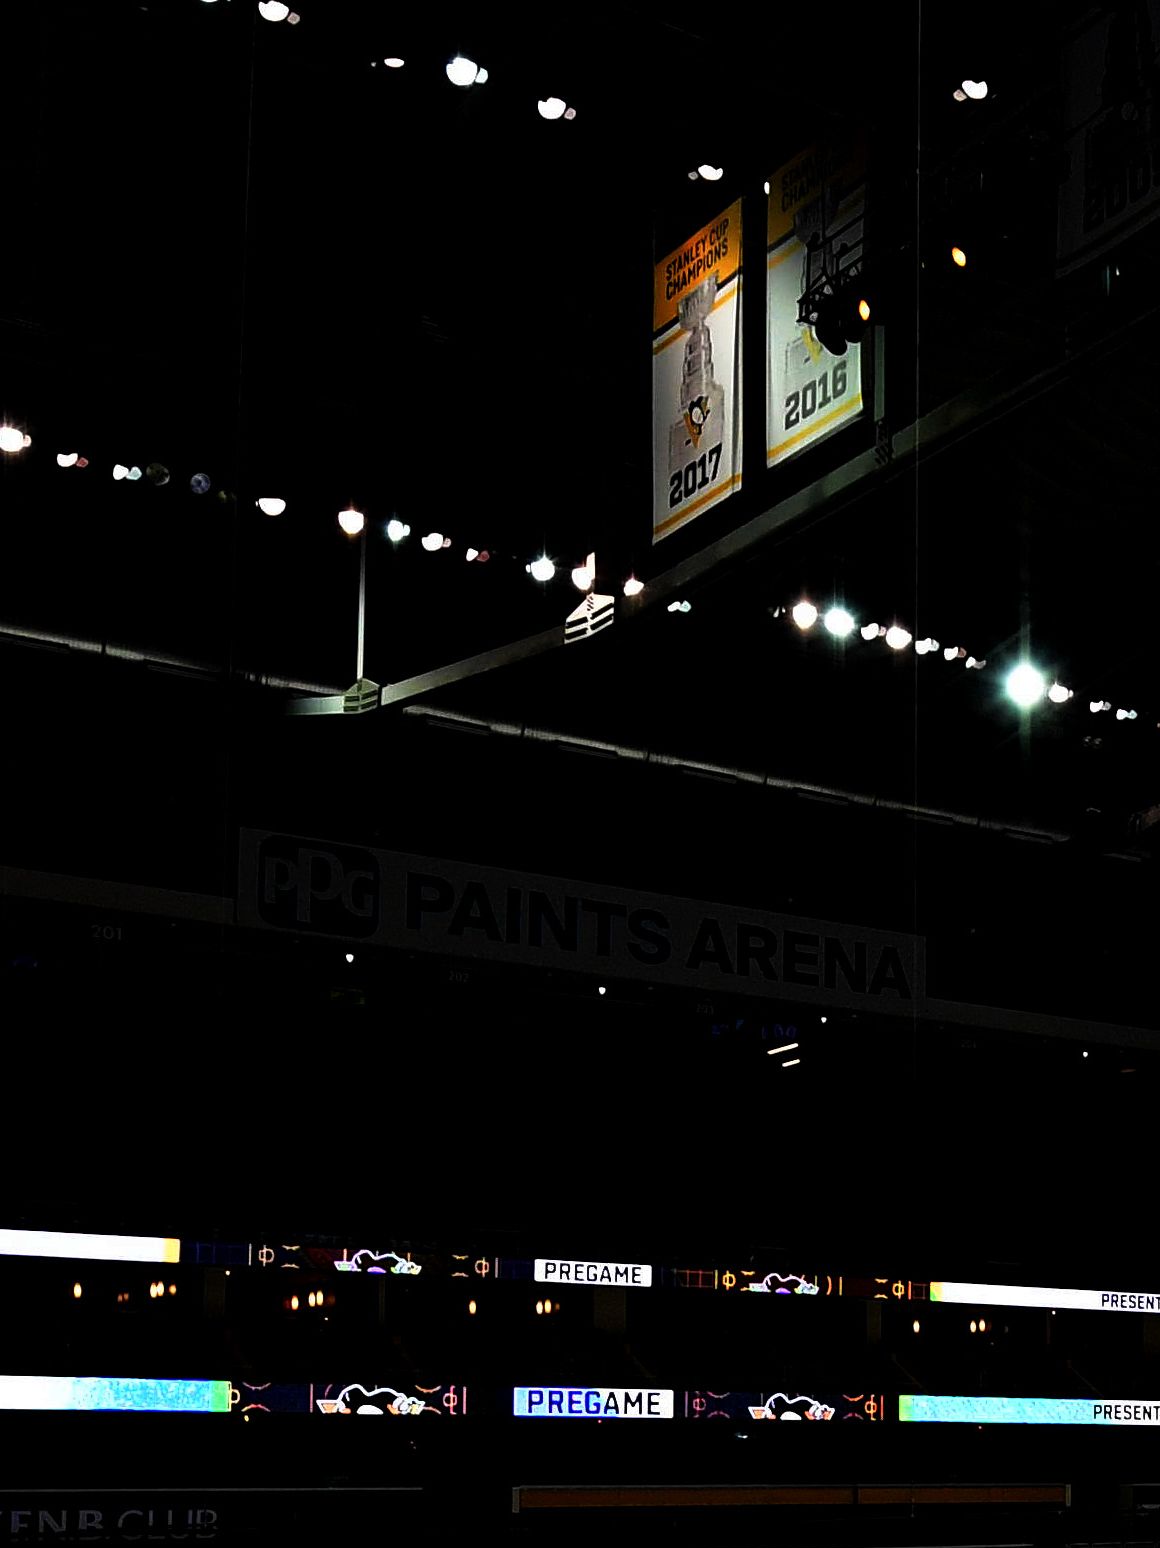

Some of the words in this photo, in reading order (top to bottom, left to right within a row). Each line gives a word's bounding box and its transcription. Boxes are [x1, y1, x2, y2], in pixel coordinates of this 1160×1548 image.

[665, 235, 708, 281] STANLEY
[709, 218, 729, 246] CUP
[666, 238, 728, 300] CHAMPIONS
[784, 362, 848, 430] 2016
[669, 445, 722, 508] 2017
[406, 878, 671, 966] PAINTS
[685, 917, 913, 999] ARENA
[544, 1262, 643, 1284] PREGAME
[528, 1391, 661, 1415] PREGAME
